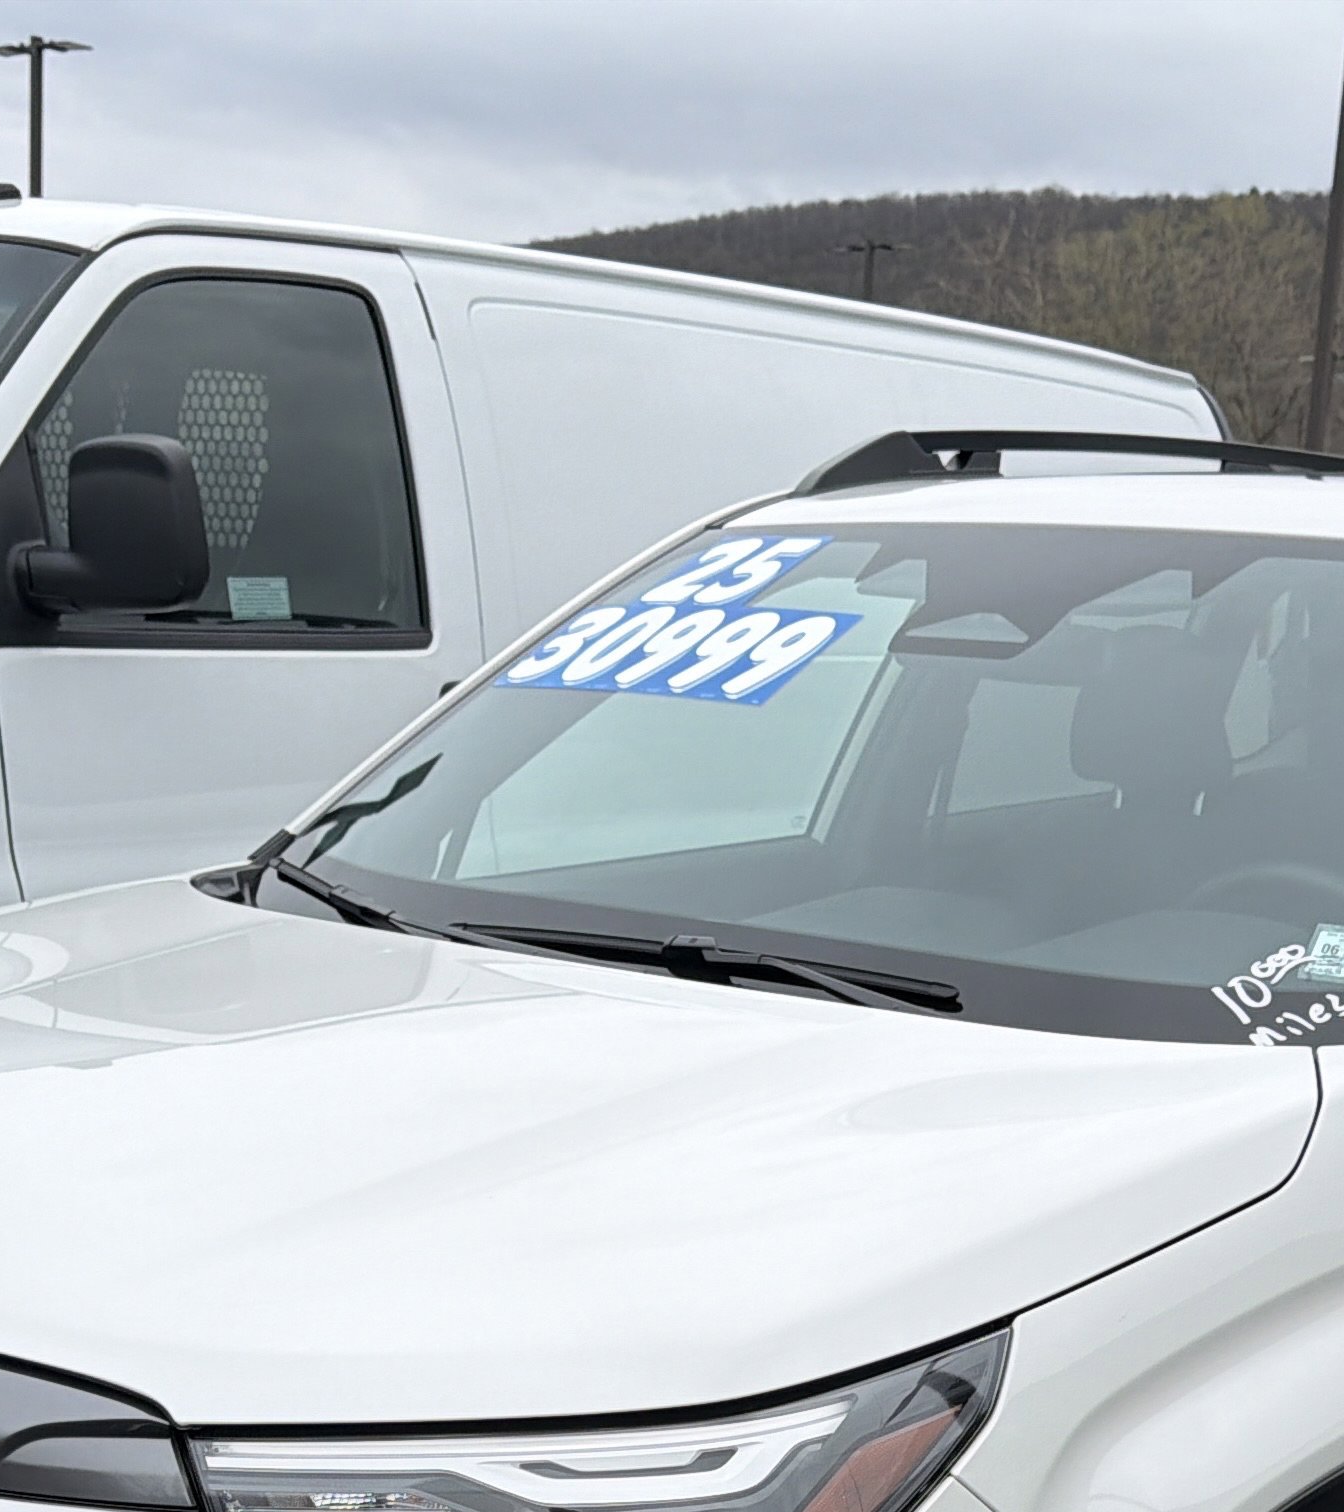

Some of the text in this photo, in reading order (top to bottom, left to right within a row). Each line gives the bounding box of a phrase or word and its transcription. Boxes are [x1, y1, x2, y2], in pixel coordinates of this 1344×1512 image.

[640, 537, 824, 606] 25
[506, 606, 837, 700] 30999
[1320, 943, 1340, 955] 06
